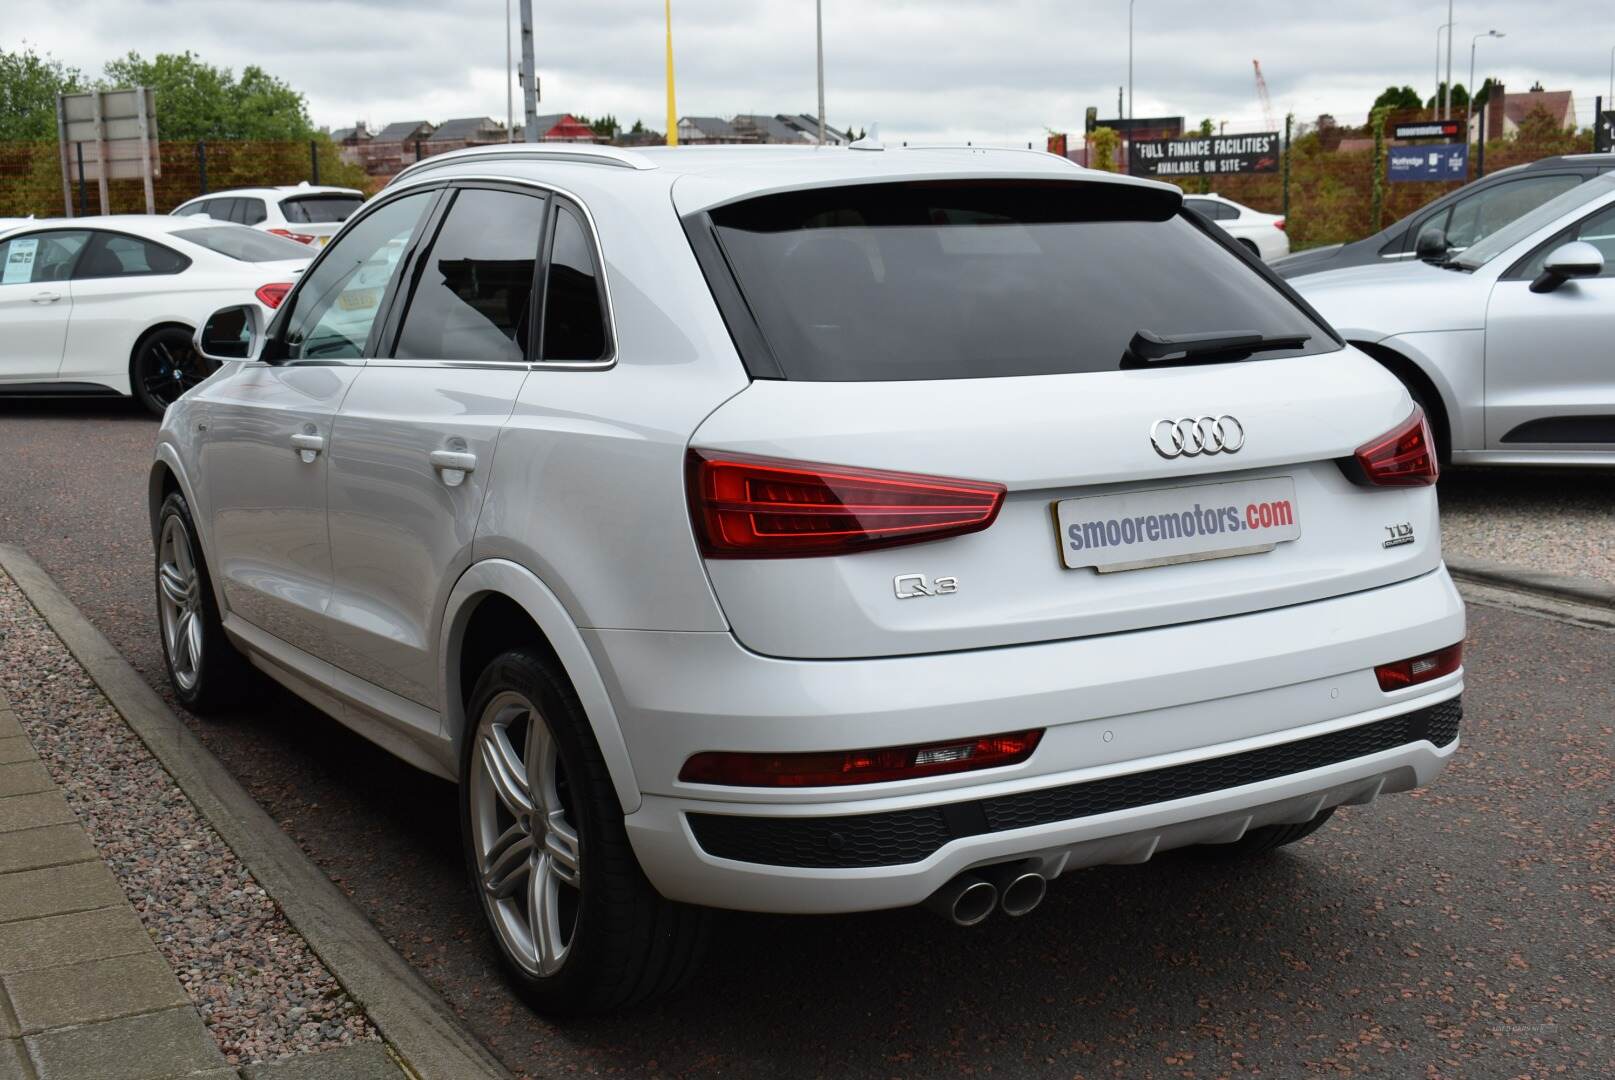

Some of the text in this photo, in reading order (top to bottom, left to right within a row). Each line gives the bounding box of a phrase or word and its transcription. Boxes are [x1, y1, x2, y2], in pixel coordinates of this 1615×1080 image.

[1168, 140, 1211, 157] FINANCE
[1203, 161, 1216, 172] ON
[1068, 500, 1294, 551] smooremotors.com
[893, 573, 958, 599] Q3
